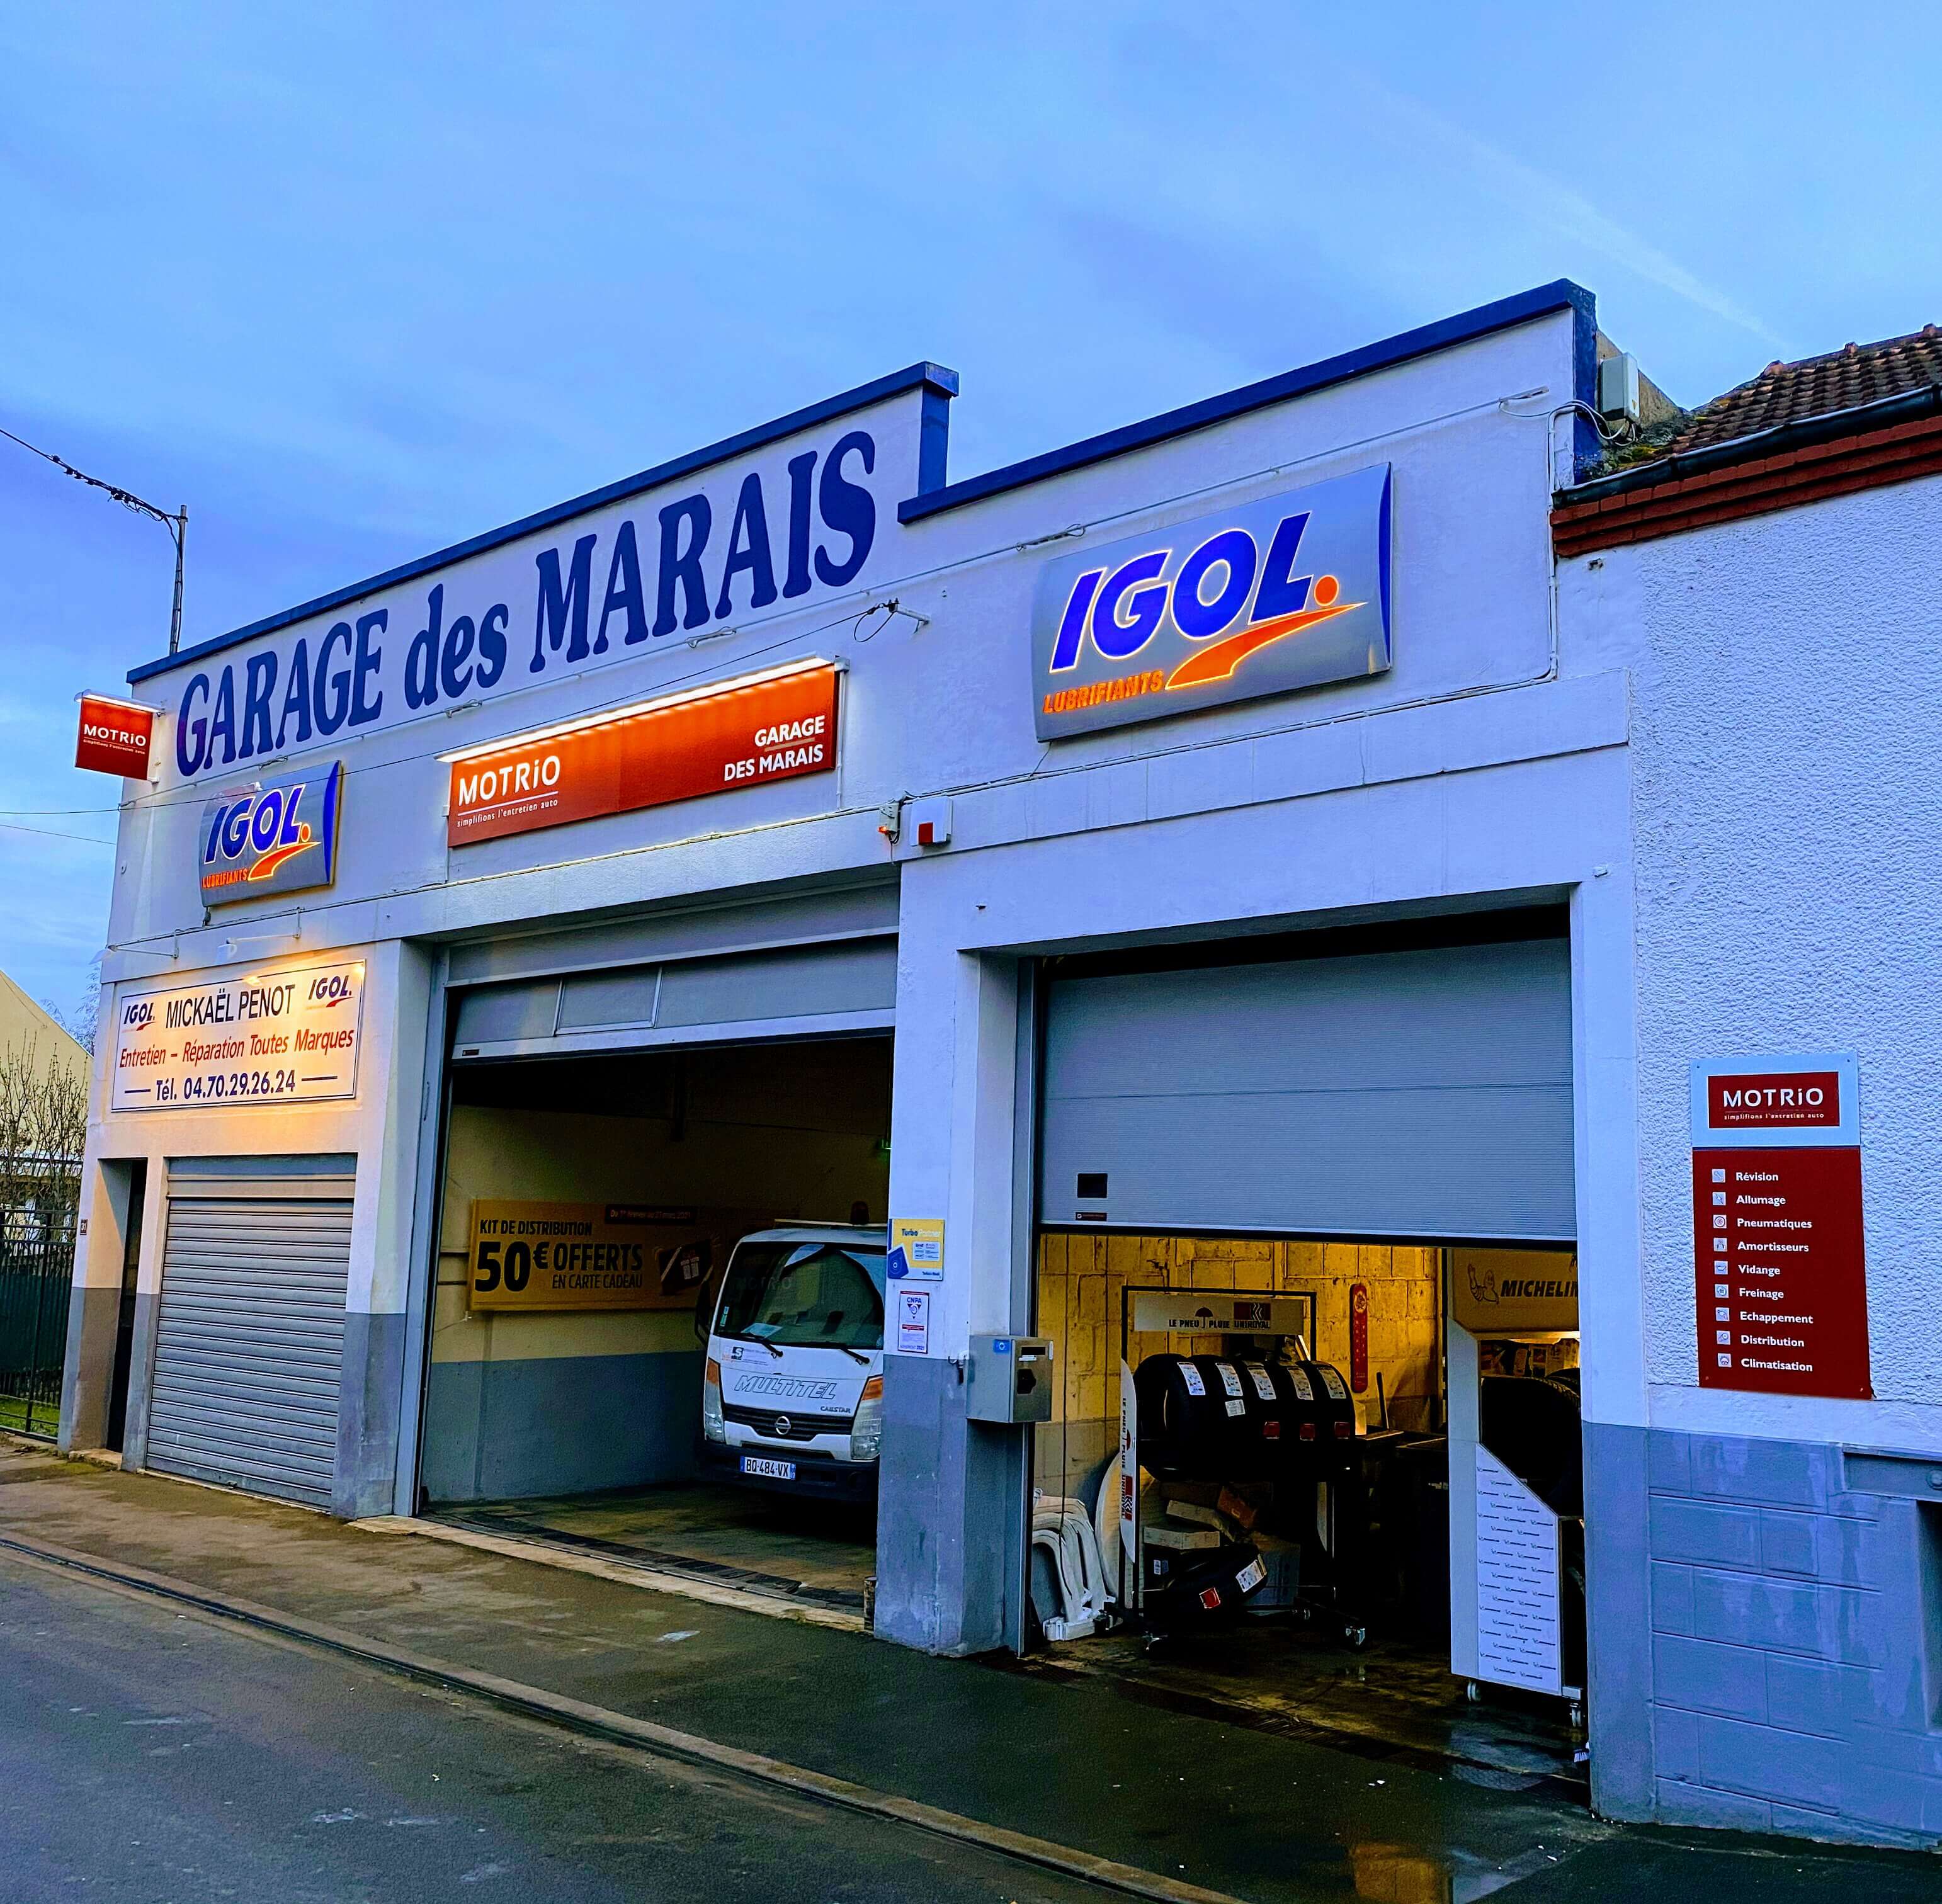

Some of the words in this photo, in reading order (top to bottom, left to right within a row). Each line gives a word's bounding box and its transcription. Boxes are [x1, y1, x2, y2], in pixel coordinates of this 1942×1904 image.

[177, 608, 388, 776] GARAGE
[404, 584, 508, 710] des
[530, 431, 875, 673] MARAIS
[1043, 669, 1164, 713] LUBRIFIANTS
[754, 715, 825, 747] GARAGE
[724, 759, 755, 781] DES
[759, 744, 824, 774] MARAIS
[457, 813, 495, 828] simplifions
[497, 803, 538, 819] l'entretien
[540, 799, 559, 810] auto
[202, 868, 248, 888] LUBRIFIANTS
[166, 988, 234, 1029] MICKAËL
[238, 984, 295, 1021] PENOT
[120, 1044, 166, 1068] Entretien
[183, 1036, 244, 1067] Réparation
[250, 1034, 289, 1056] Toutes
[294, 1028, 354, 1056] Marques
[156, 1079, 177, 1101] Tél.
[184, 1069, 295, 1100] 04.70.29.26.24
[1735, 1172, 1779, 1181] Révision
[1736, 1195, 1786, 1207] Allumage
[480, 1220, 498, 1234] KIT
[501, 1220, 515, 1235] DE
[518, 1220, 592, 1236] DISTRIBUTION
[1737, 1218, 1812, 1230] Pneumatiques
[1737, 1242, 1809, 1252] Amortisseurs
[554, 1242, 643, 1272] OFFERTS
[1738, 1264, 1781, 1277] Vidange
[552, 1274, 567, 1289] EN
[569, 1274, 600, 1289] CARTE
[603, 1274, 643, 1289] CADEAU
[1739, 1288, 1784, 1301] Freinage
[1169, 1319, 1177, 1327] LE
[1179, 1319, 1200, 1328] PNEU
[1208, 1320, 1230, 1329] PLUIE
[1234, 1320, 1270, 1329] UNIROYAL
[1740, 1311, 1814, 1324] Echappement
[1740, 1334, 1805, 1347] Distribution
[1740, 1358, 1814, 1372] Climatisation
[734, 1374, 838, 1400] MULTITEL
